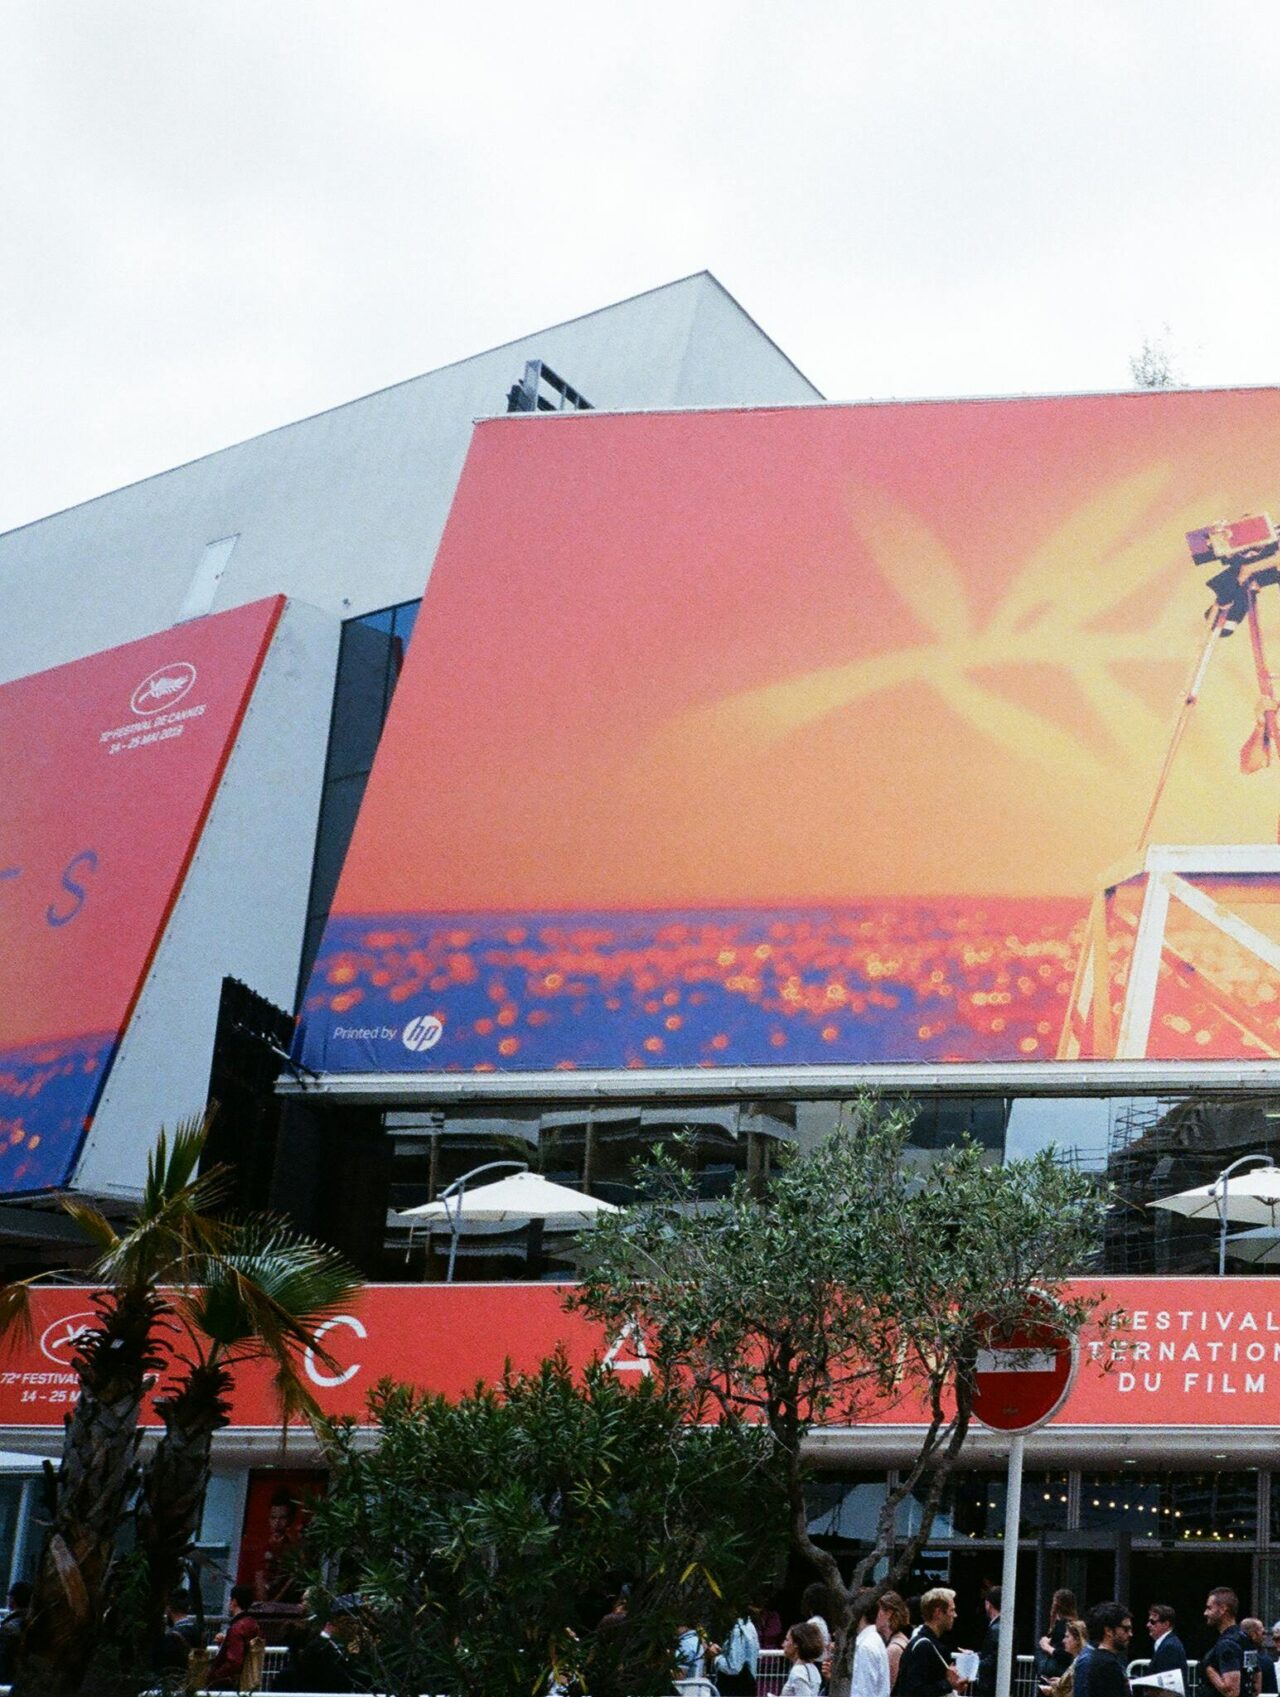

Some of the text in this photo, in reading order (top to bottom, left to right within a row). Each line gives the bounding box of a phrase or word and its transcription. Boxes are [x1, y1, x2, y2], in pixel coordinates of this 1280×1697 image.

[46, 848, 98, 928] S
[332, 1015, 442, 1052] Printed by hp
[22, 1372, 80, 1384] FESTIVAL
[1118, 1372, 1266, 1393] DU FILM
[21, 1391, 36, 1402] 14
[50, 1391, 67, 1402] 25
